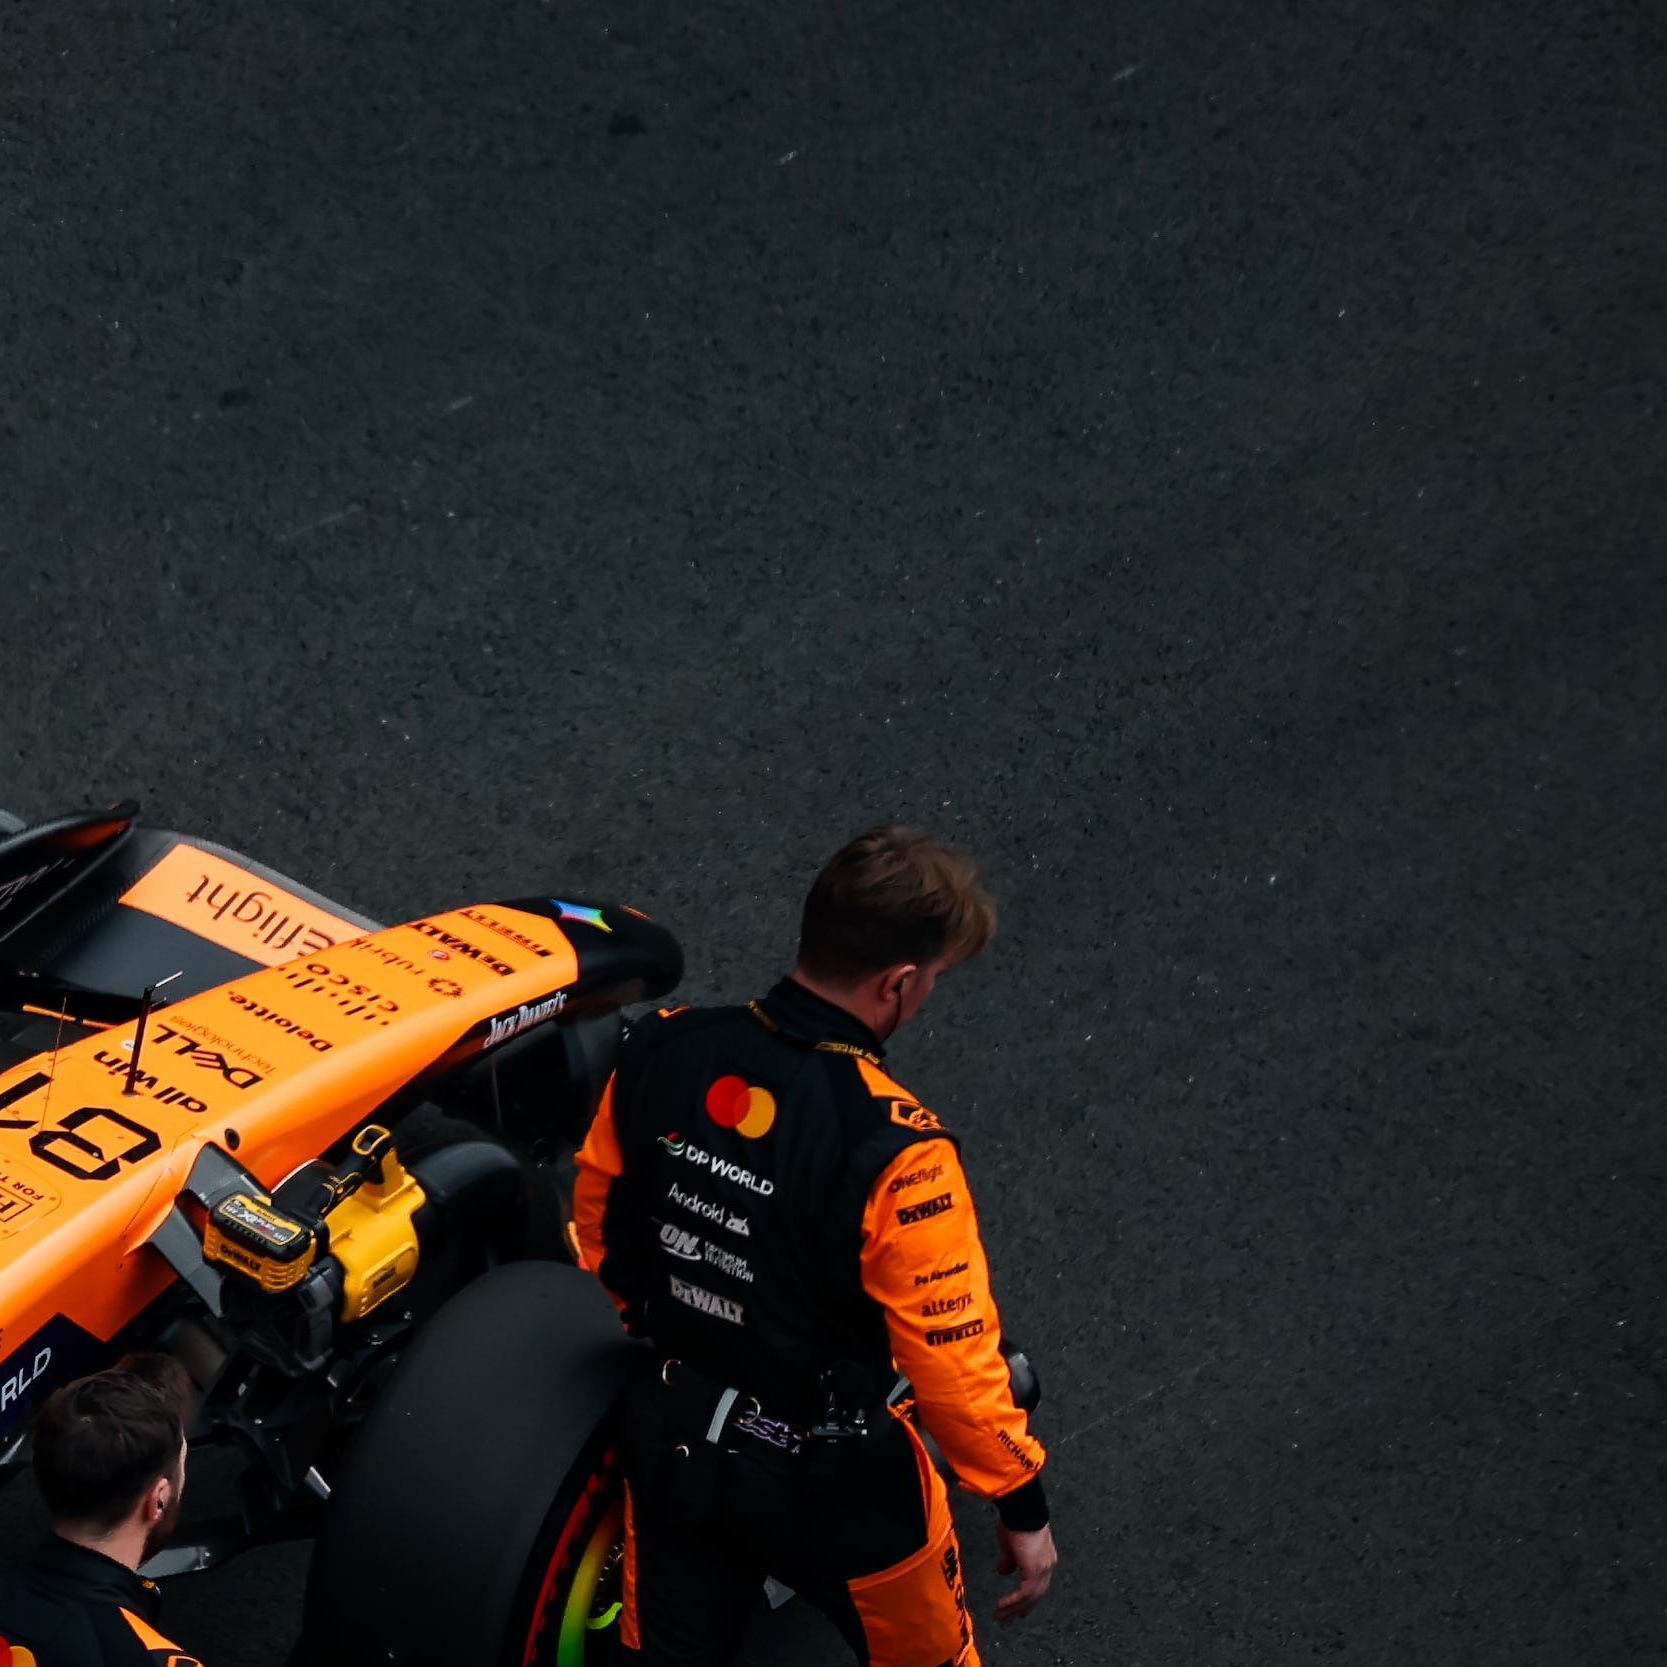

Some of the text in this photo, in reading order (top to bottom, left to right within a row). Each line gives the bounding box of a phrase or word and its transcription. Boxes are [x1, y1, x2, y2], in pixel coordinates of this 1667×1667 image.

[185, 873, 341, 966] Eflight
[461, 908, 555, 957] PIRELLI
[349, 937, 424, 976] rubrik
[148, 1023, 265, 1090] DELL
[153, 1085, 208, 1114] all
[12, 1182, 44, 1201] FOR
[686, 1143, 775, 1198] DP WORLD
[667, 1182, 724, 1226] Android
[922, 1293, 974, 1317] alteryx
